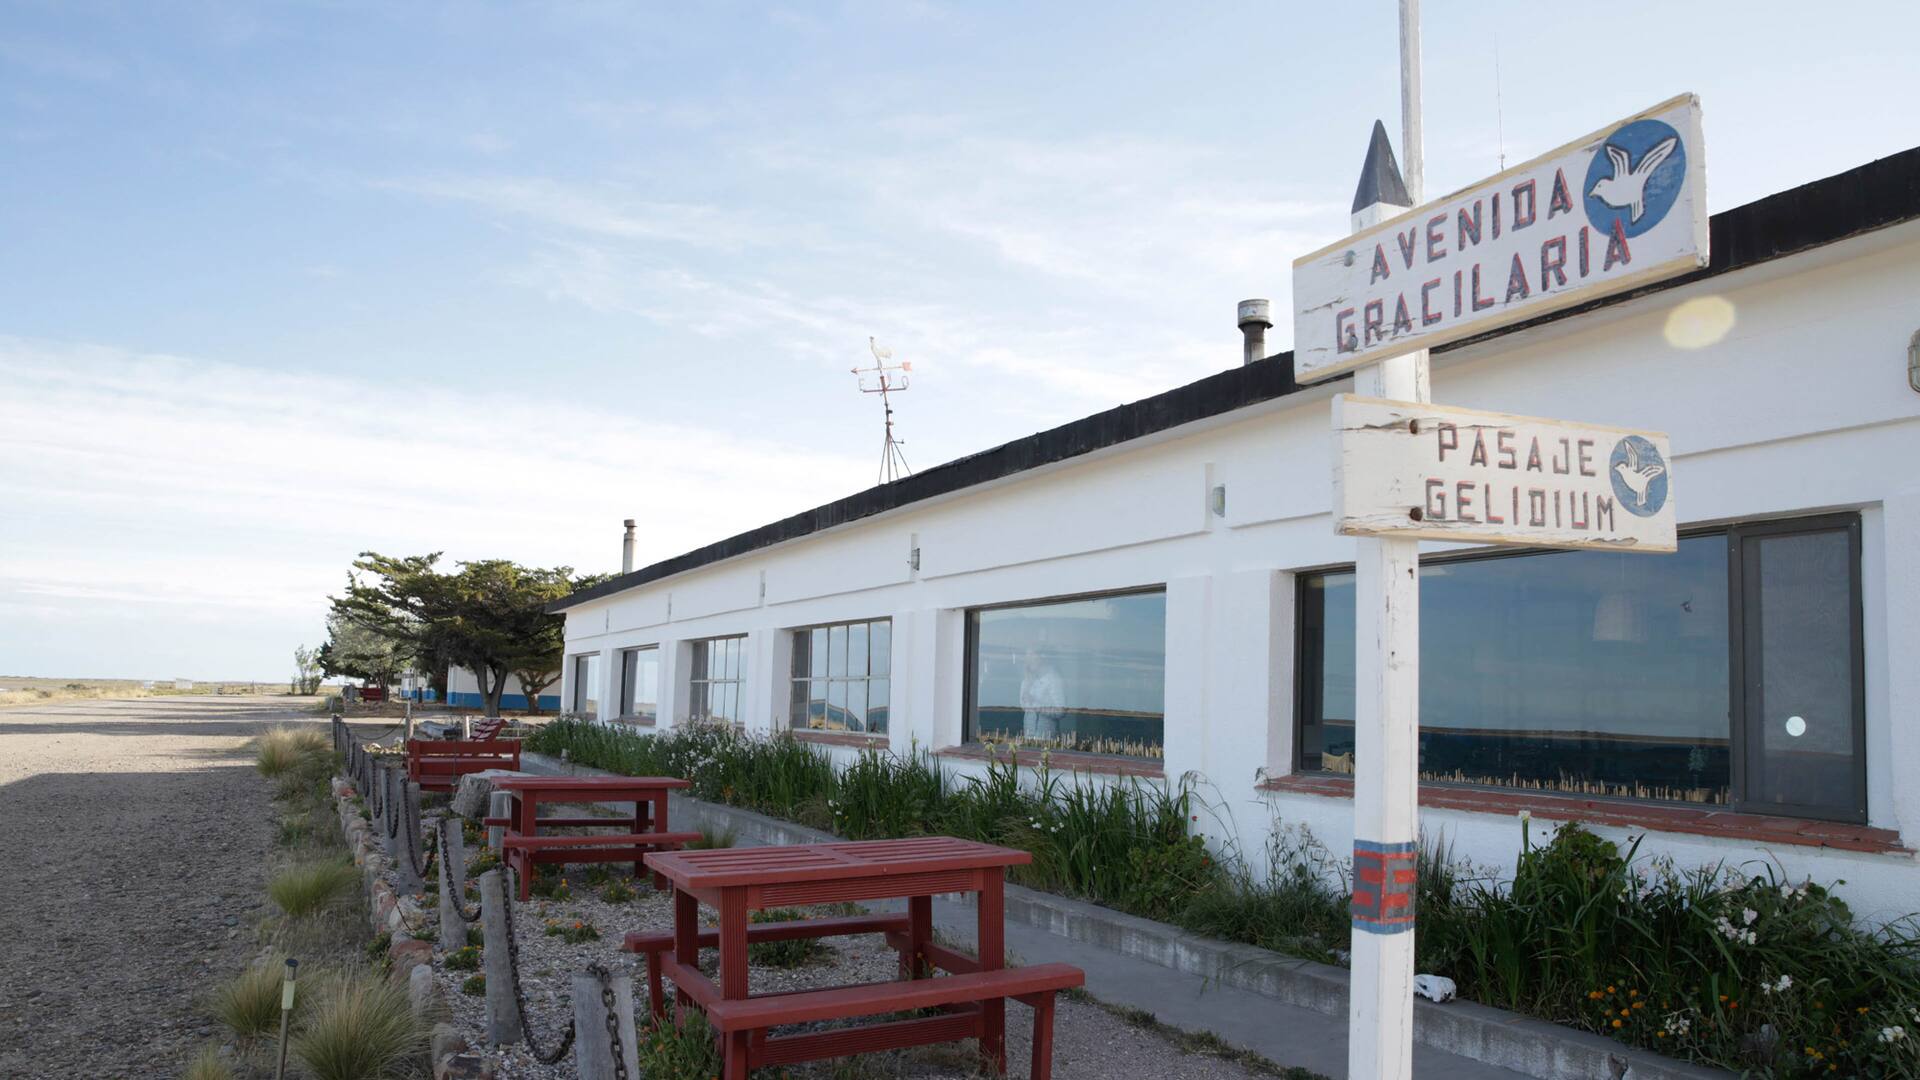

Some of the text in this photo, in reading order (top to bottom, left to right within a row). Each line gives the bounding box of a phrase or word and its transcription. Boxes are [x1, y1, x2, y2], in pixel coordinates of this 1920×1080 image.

[1370, 168, 1573, 285] AVENIDA
[1336, 218, 1632, 354] GRACILARIA
[1438, 422, 1596, 477] PASAJE
[1425, 478, 1615, 532] GELIDIUM
